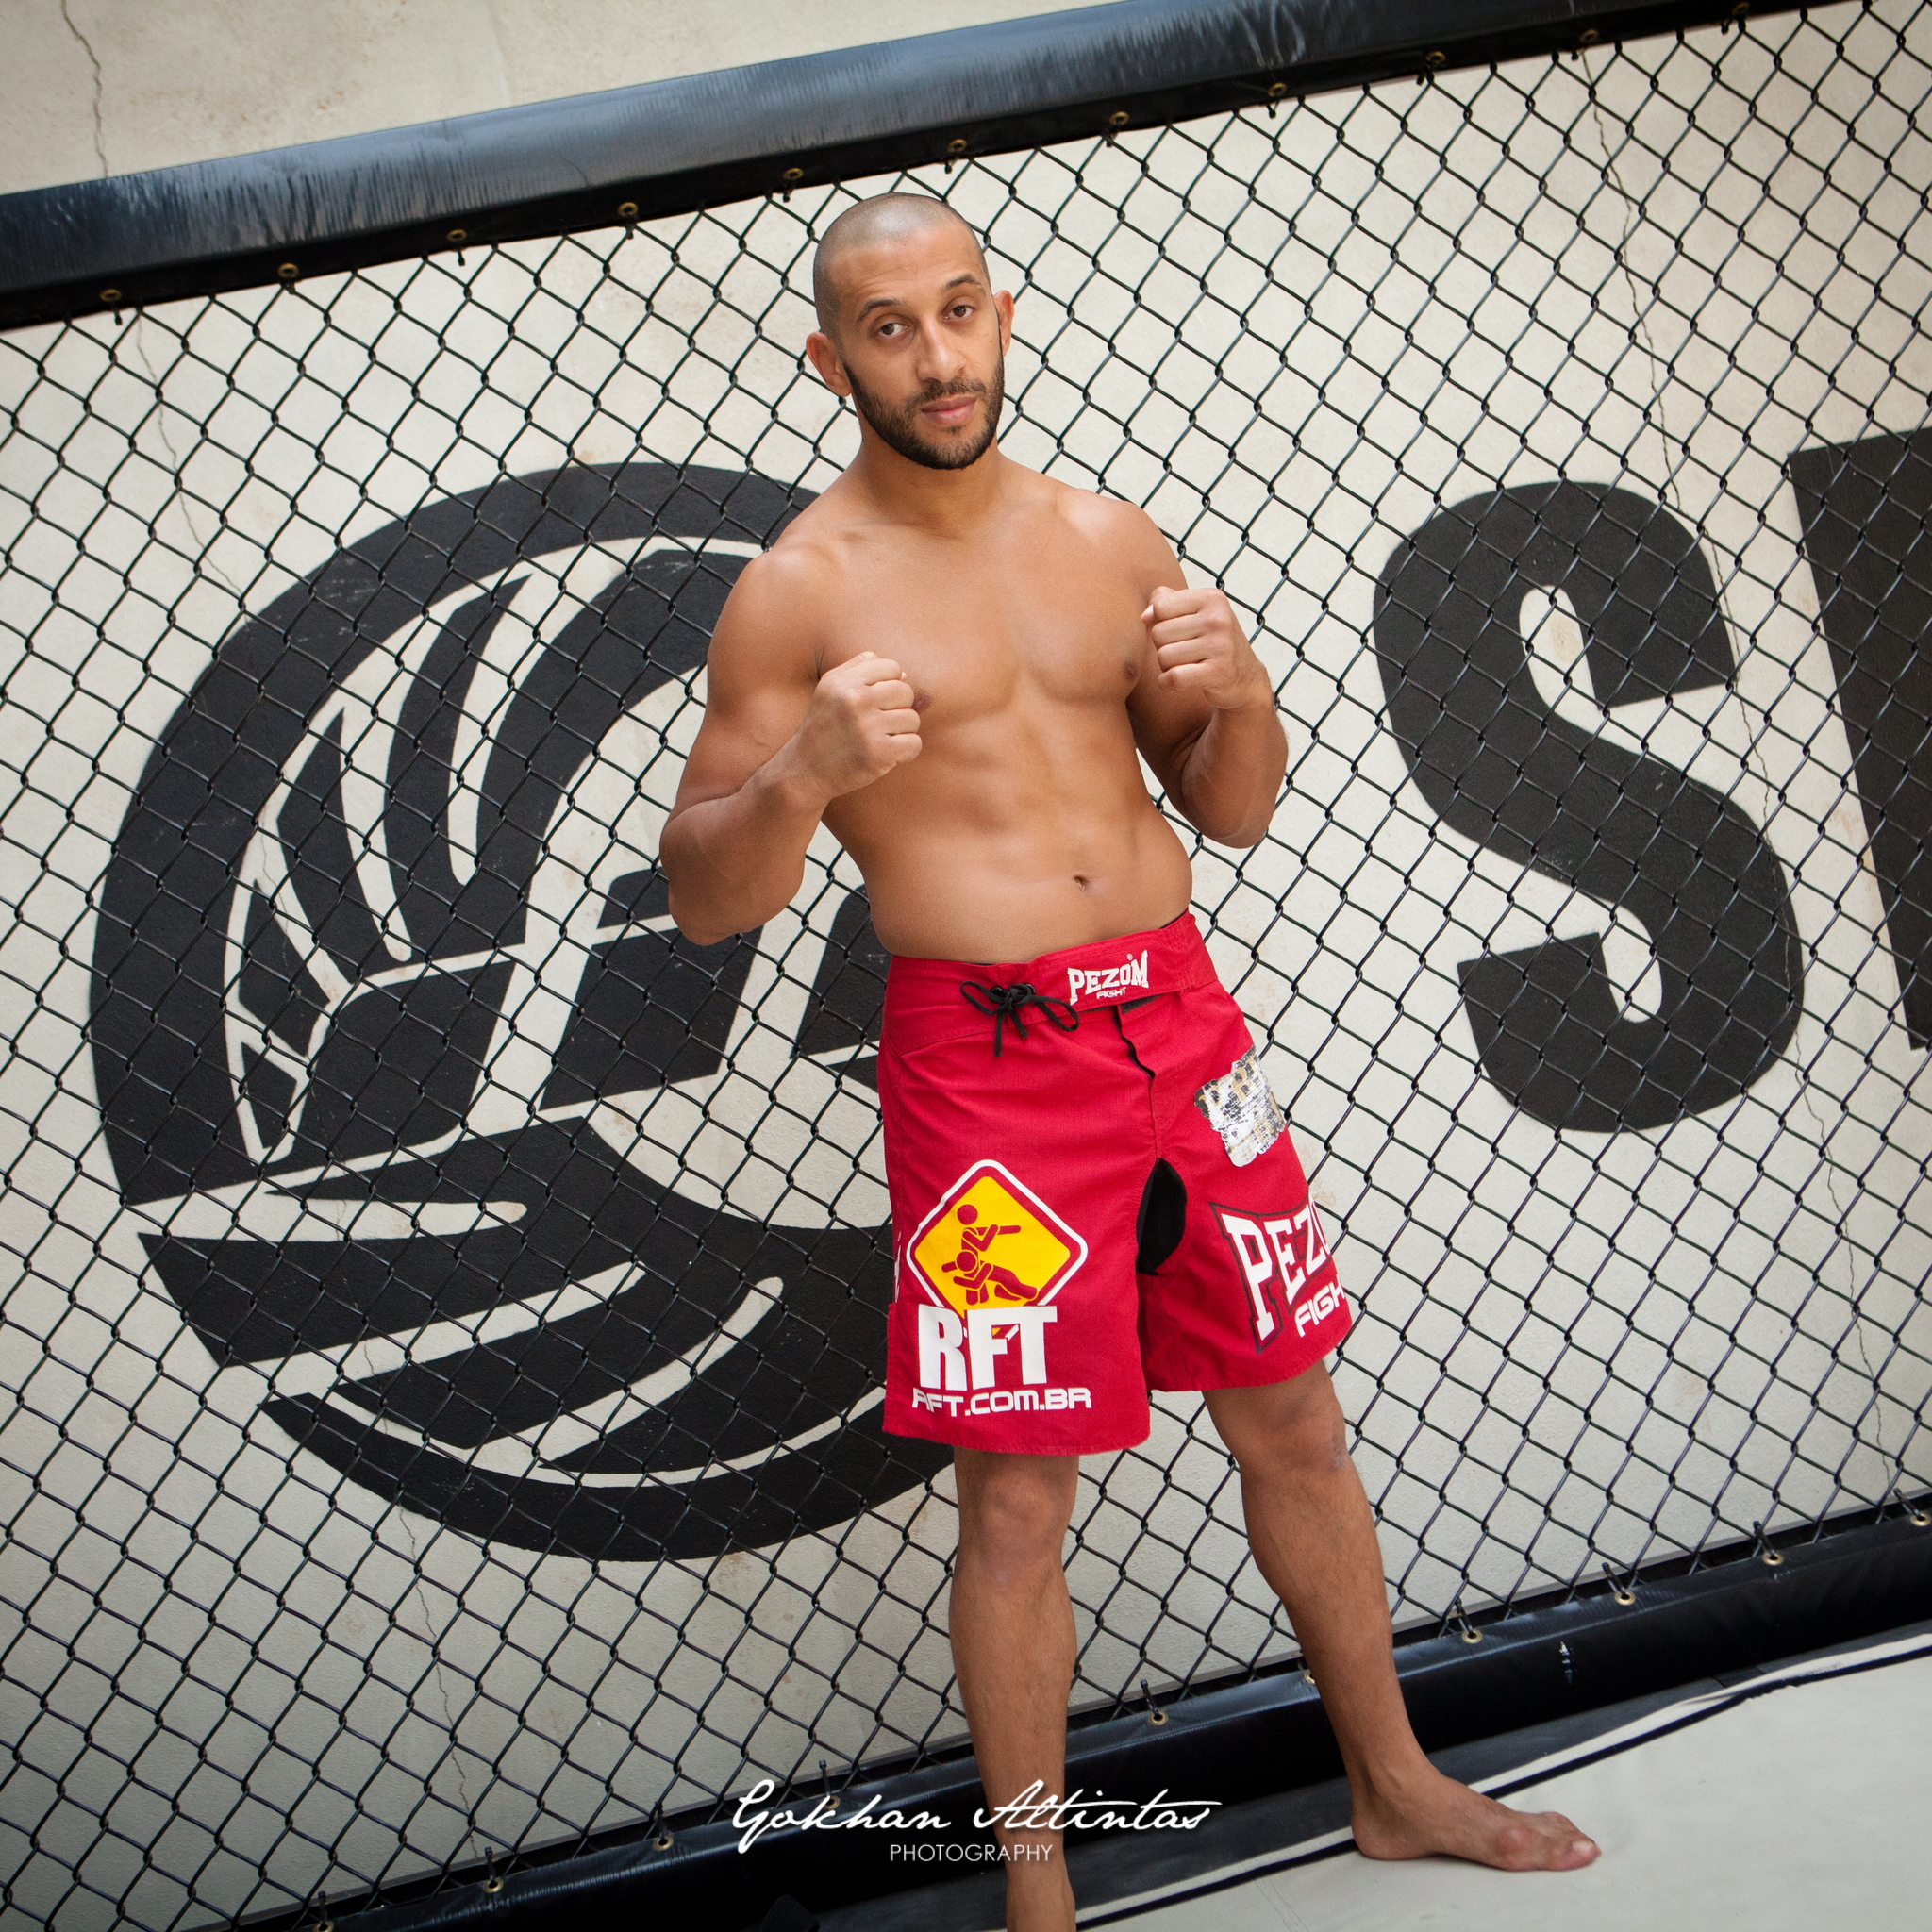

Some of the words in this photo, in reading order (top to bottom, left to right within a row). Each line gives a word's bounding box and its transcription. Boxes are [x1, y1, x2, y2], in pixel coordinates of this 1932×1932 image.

[1067, 949, 1149, 1006] PEZOM
[1096, 987, 1127, 1000] FIGHT
[1221, 1191, 1331, 1341] PEZ
[1295, 1274, 1346, 1338] FIGH
[918, 1304, 1058, 1391] RFT
[912, 1387, 1092, 1417] RFT.COM.BR
